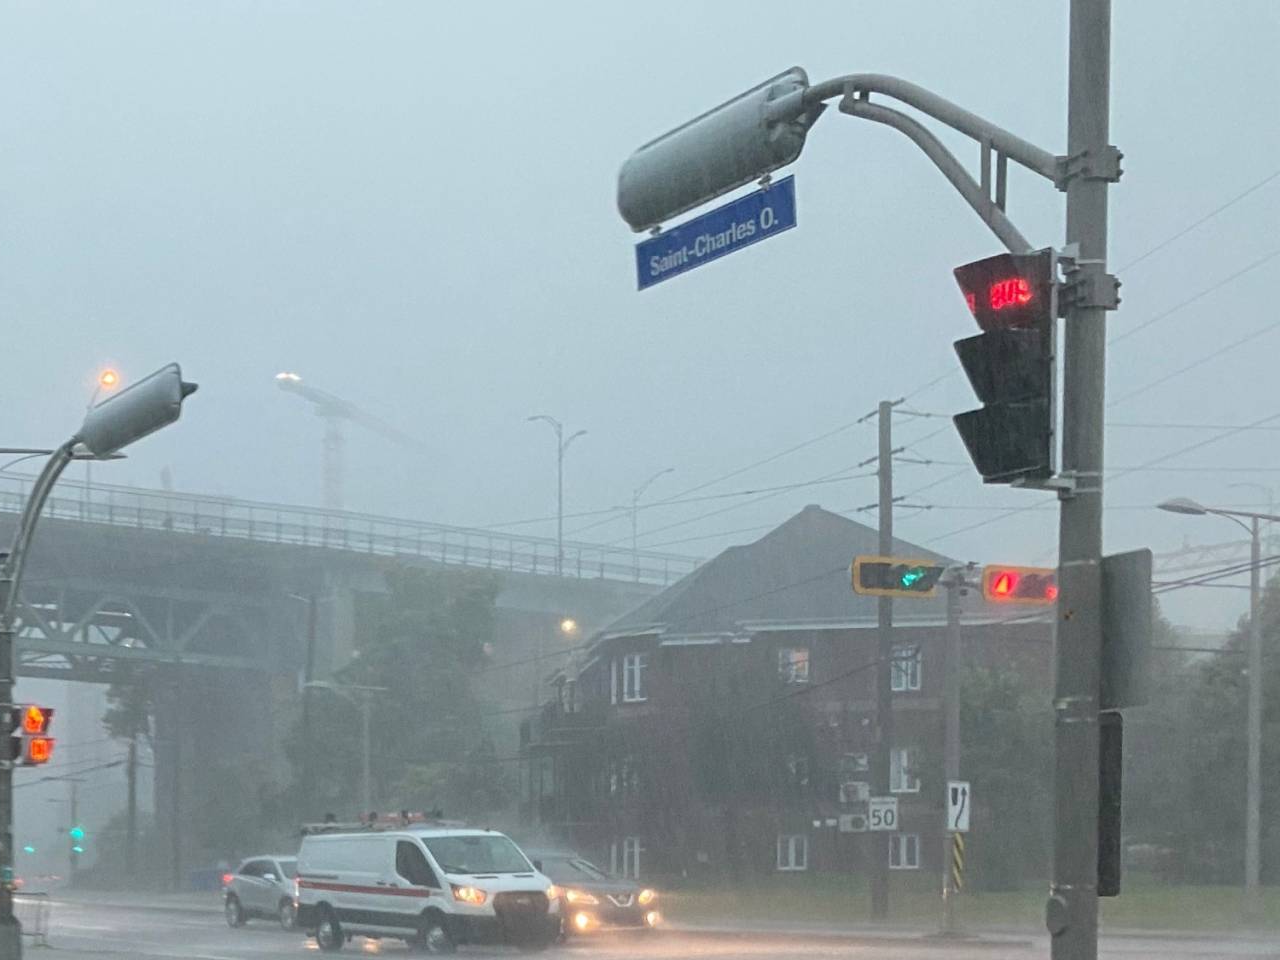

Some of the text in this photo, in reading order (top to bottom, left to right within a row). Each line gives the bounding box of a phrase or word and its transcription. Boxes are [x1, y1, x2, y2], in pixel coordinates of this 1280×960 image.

[650, 207, 778, 277] Saint-Charles O.
[872, 809, 894, 826] 50
